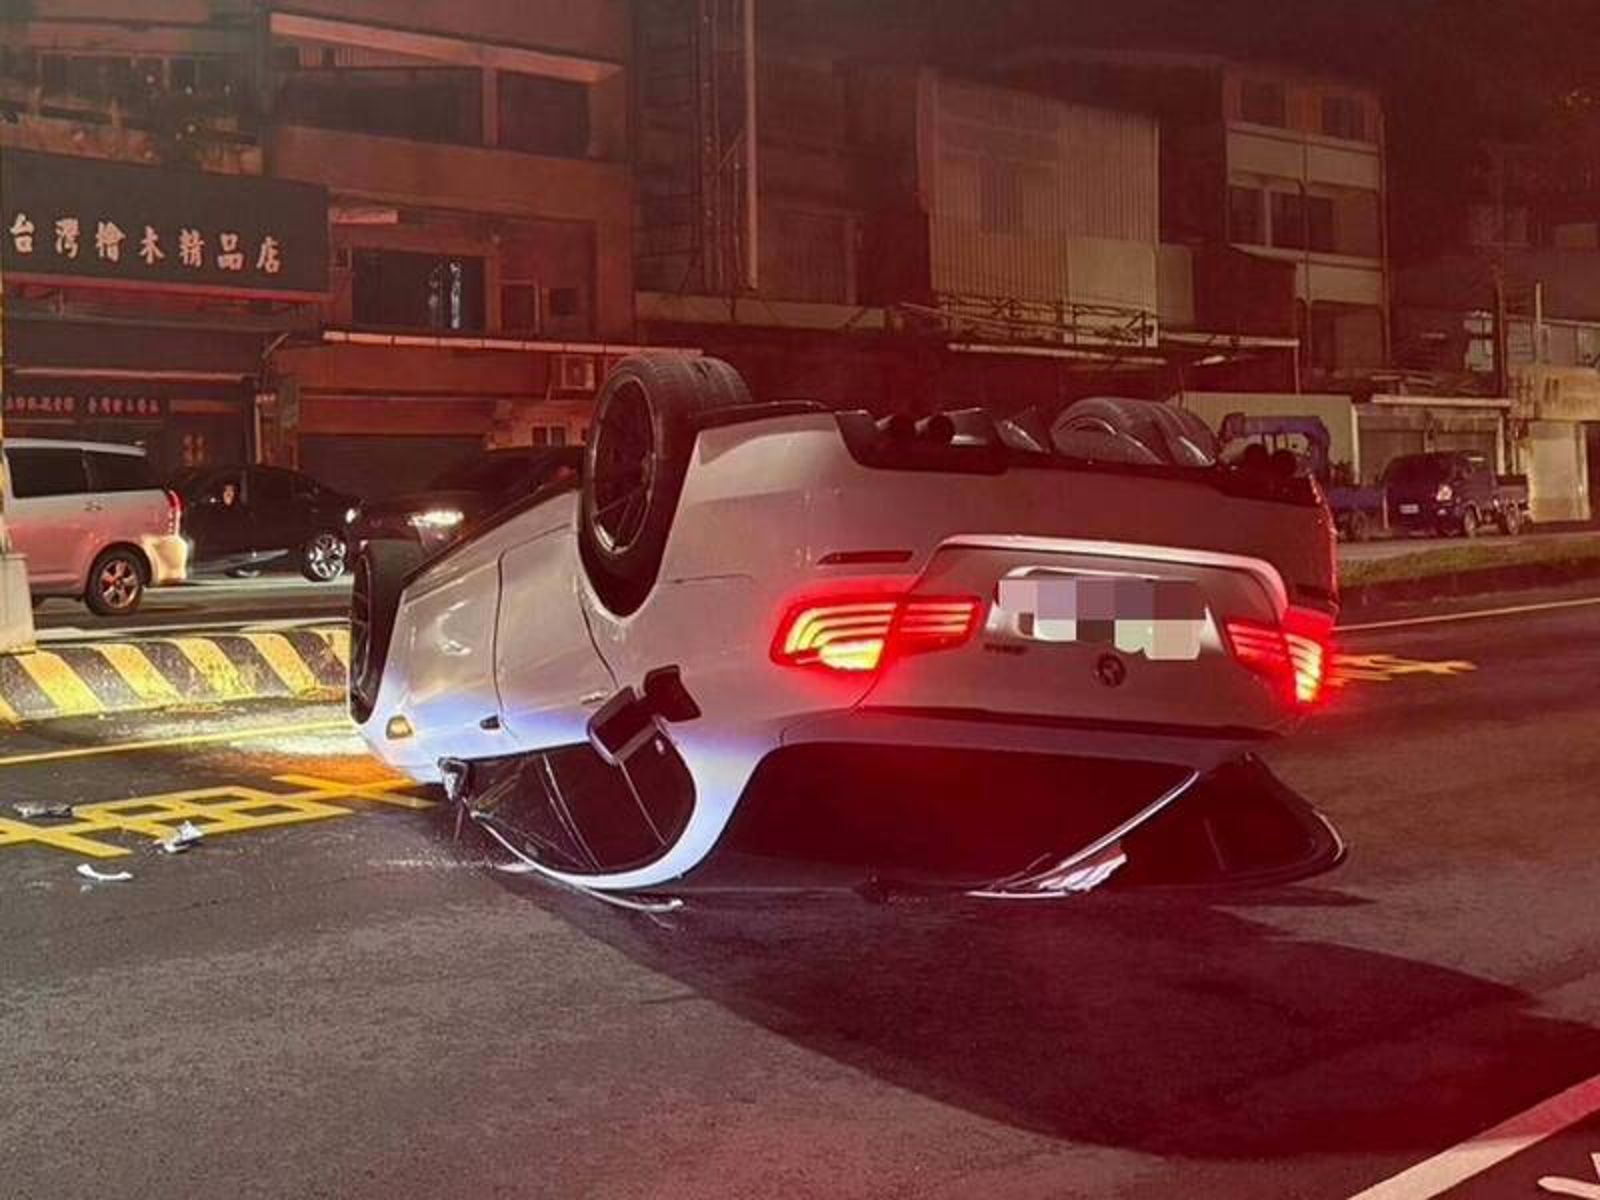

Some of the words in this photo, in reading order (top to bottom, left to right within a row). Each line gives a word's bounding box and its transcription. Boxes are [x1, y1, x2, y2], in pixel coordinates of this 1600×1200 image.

[9, 212, 281, 273] 台灣檜木精品店
